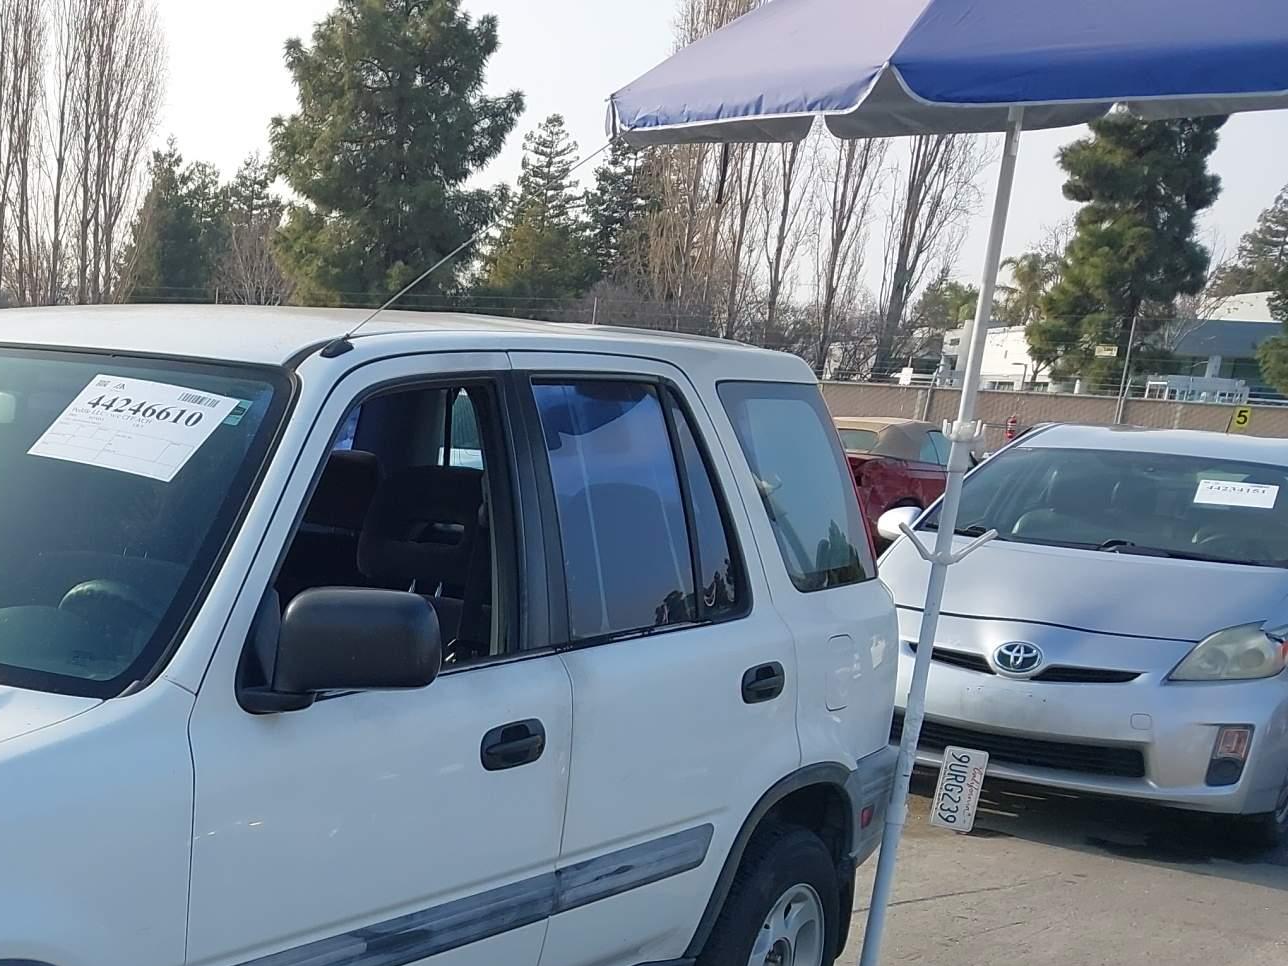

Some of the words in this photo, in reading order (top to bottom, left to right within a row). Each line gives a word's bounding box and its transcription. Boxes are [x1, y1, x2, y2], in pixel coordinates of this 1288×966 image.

[88, 395, 203, 427] 44246610
[1236, 410, 1248, 425] 5
[938, 752, 971, 824] 9URG239
